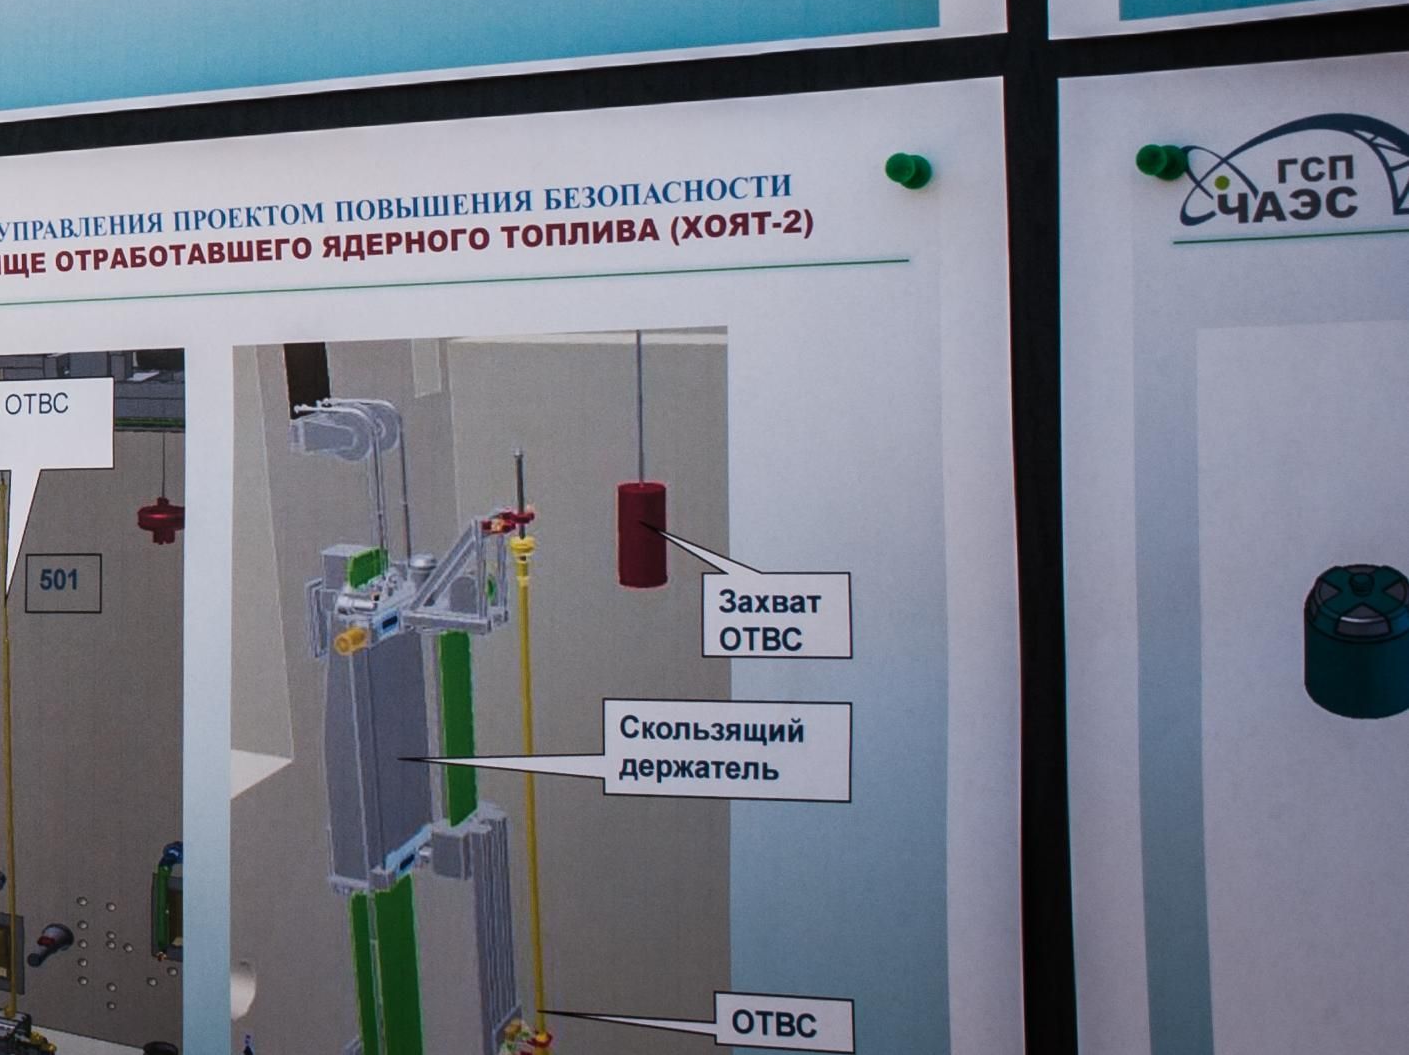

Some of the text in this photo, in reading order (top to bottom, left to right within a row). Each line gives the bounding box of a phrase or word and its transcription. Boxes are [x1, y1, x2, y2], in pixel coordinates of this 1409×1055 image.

[1278, 155, 1354, 183] ГСП
[174, 203, 323, 231] ПРОЕКТОМ
[337, 190, 531, 222] ПОВЫШЕНИЯ
[545, 175, 791, 210] БЕЗОПАСНОСТИ
[1218, 186, 1358, 223] ЧАЭС
[56, 238, 312, 272] ОТРАБОТАВШЕГО
[323, 228, 489, 261] ЯДЕРНОГО
[501, 218, 660, 248] ТОПЛИВА
[671, 209, 813, 246] (ХОЯТ-2)
[6, 392, 68, 415] ОТВС
[40, 569, 78, 591] 501
[719, 589, 821, 613] Захват
[719, 627, 802, 652] ОТВС
[620, 715, 803, 746] Скользящий
[619, 759, 779, 783] держатель
[732, 1010, 818, 1039] ОТВС
